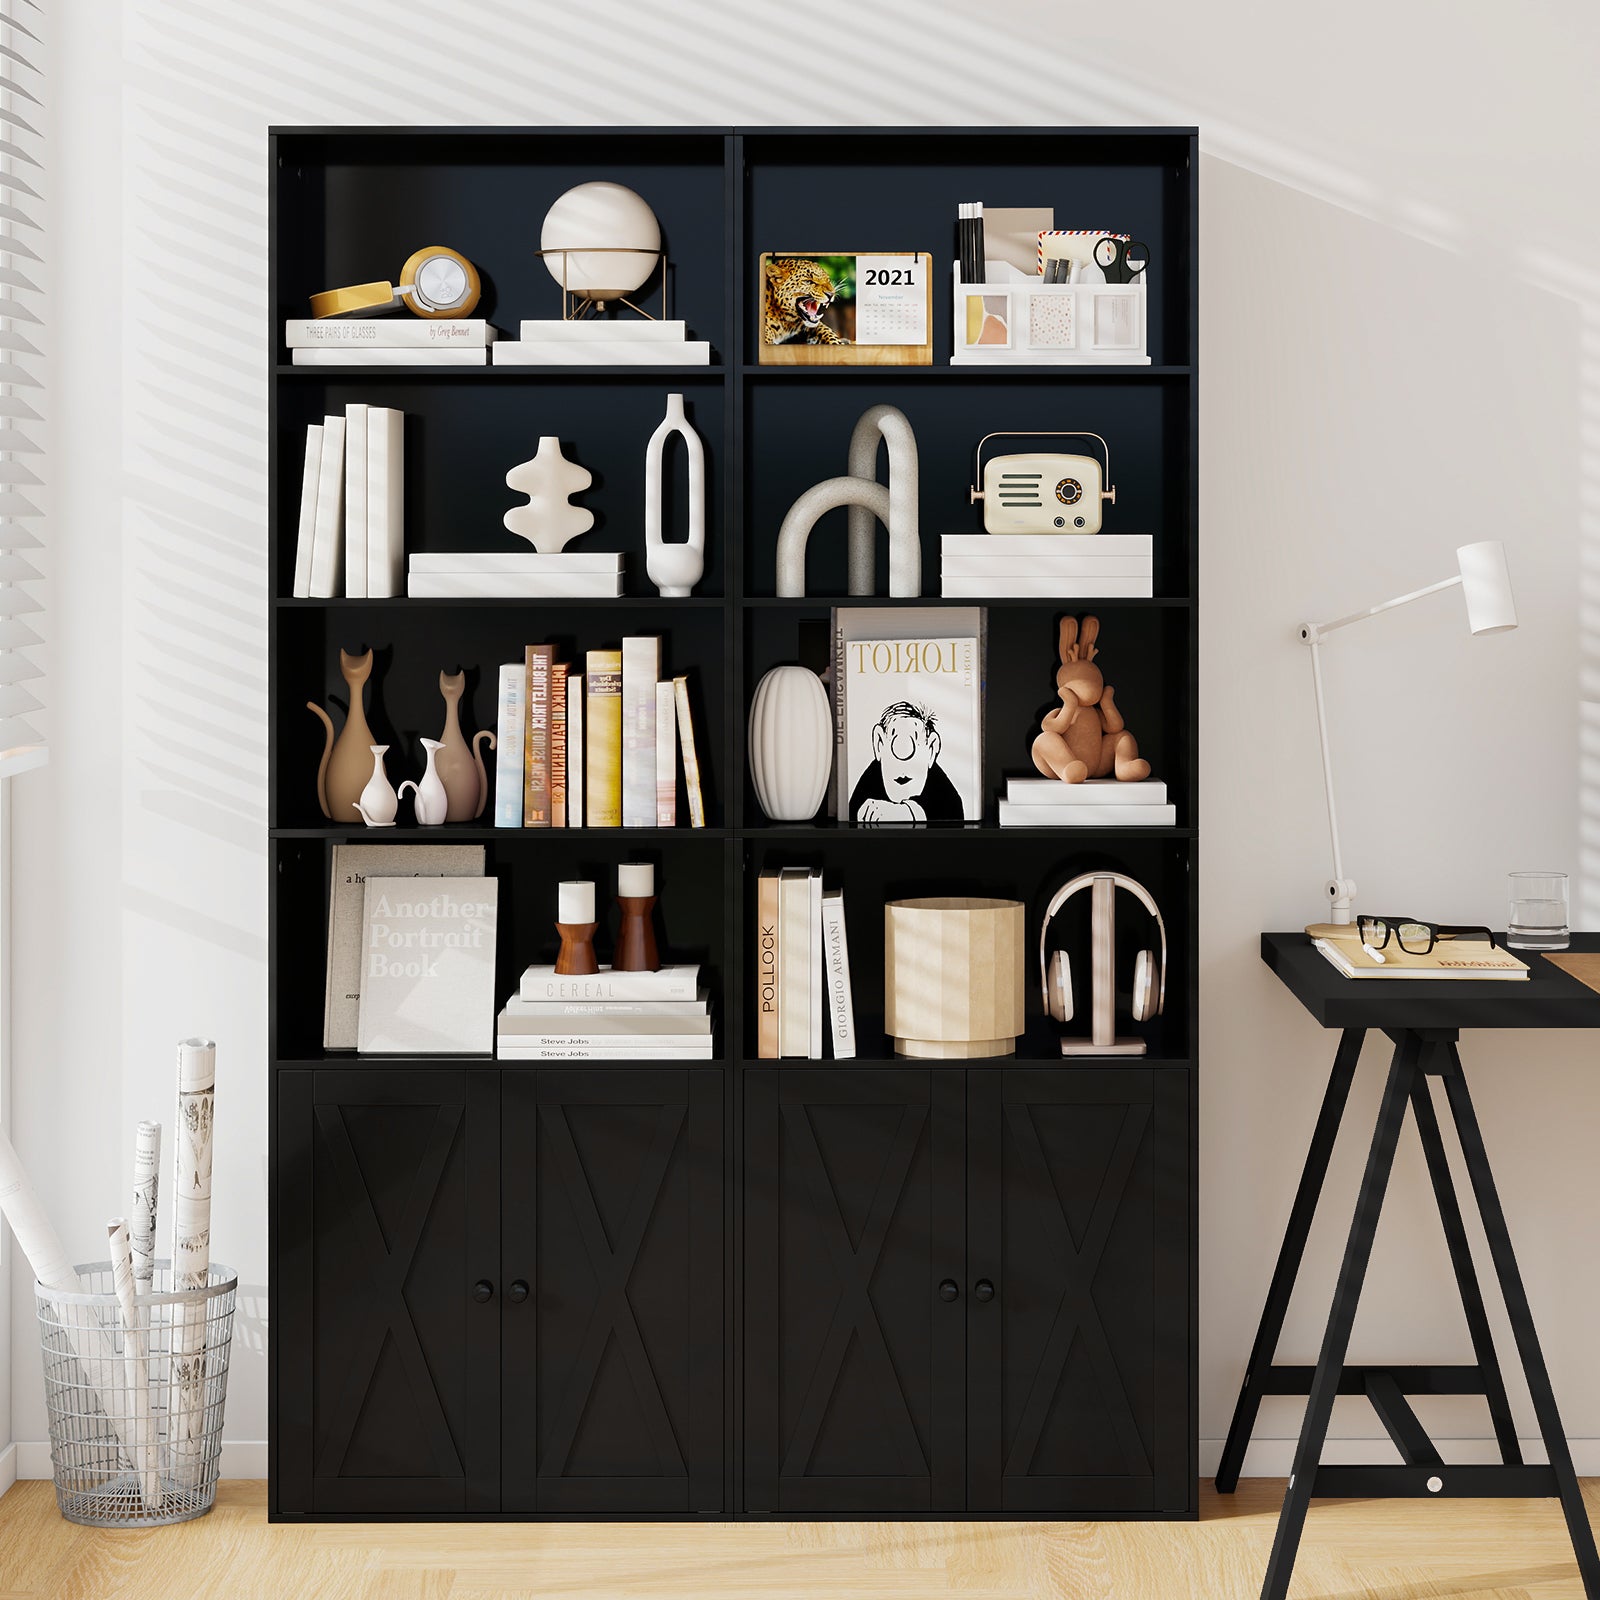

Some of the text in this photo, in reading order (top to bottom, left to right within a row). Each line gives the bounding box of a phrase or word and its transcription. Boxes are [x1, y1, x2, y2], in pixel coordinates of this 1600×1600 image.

[865, 269, 915, 286] 2021
[306, 326, 377, 339] THREE PAIRS OF GLASSES
[429, 326, 437, 339] by
[437, 325, 451, 340] Greg
[345, 875, 352, 884] a
[370, 894, 490, 918] Another
[369, 923, 483, 948] Portrait
[368, 953, 440, 978] Book
[762, 925, 775, 1013] POLLOCK
[829, 920, 848, 1039] GIORGIO ARMANI
[546, 983, 615, 998] CEREAL
